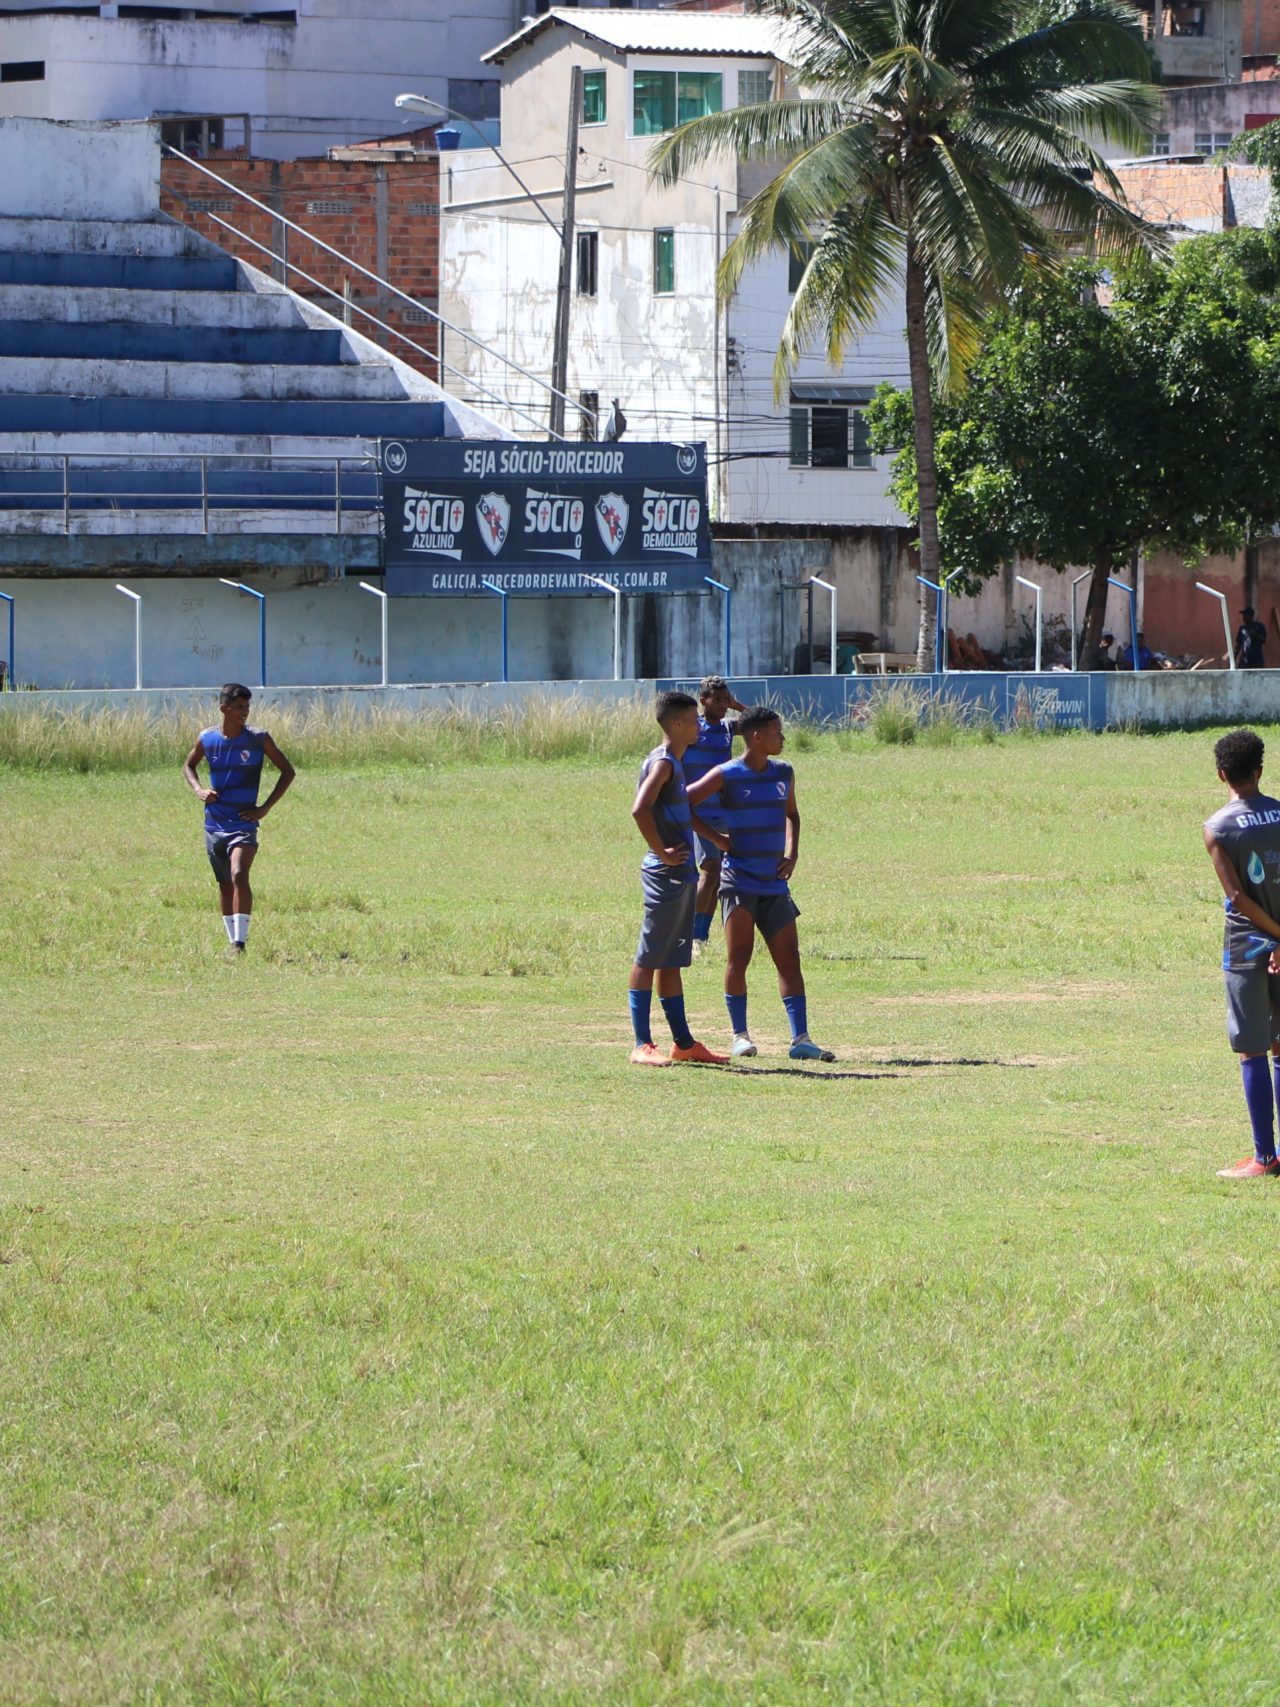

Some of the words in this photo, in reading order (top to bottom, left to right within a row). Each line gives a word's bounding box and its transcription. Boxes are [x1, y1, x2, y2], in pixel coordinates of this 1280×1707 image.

[464, 449, 496, 479] SEJA
[500, 445, 624, 474] SÓCIO-TORCEDOR
[403, 491, 465, 533] SÓCIO
[524, 492, 584, 533] SÓCIO
[641, 490, 701, 532] SÓCIO
[412, 534, 455, 549] AZULINO
[643, 532, 697, 547] DEMOLIDOR
